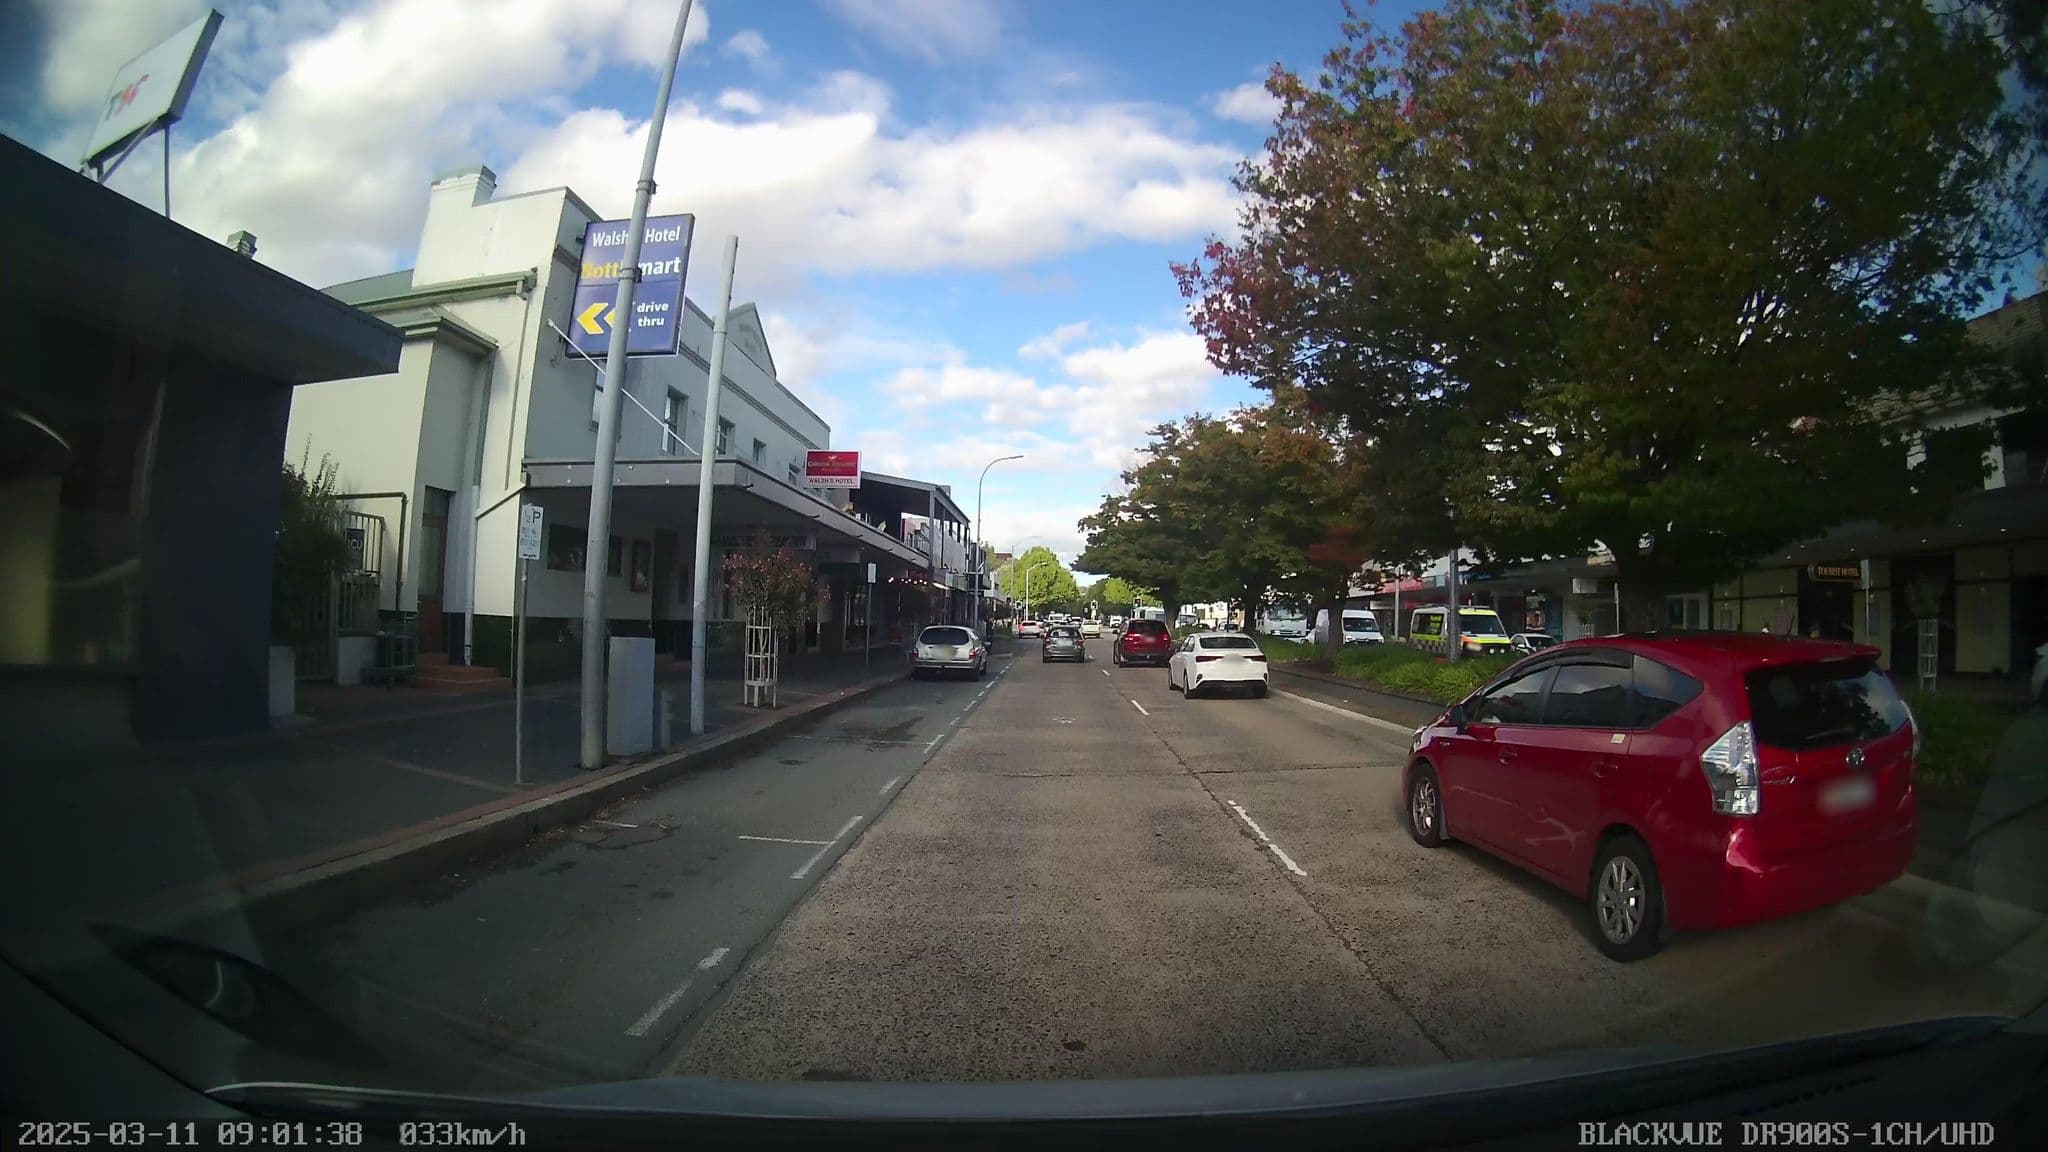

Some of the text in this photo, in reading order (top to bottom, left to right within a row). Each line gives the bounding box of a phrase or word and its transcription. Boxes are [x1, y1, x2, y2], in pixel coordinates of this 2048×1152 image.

[645, 226, 680, 243] Hotel
[637, 301, 669, 313] drive
[637, 316, 665, 327] thru
[533, 511, 541, 523] P
